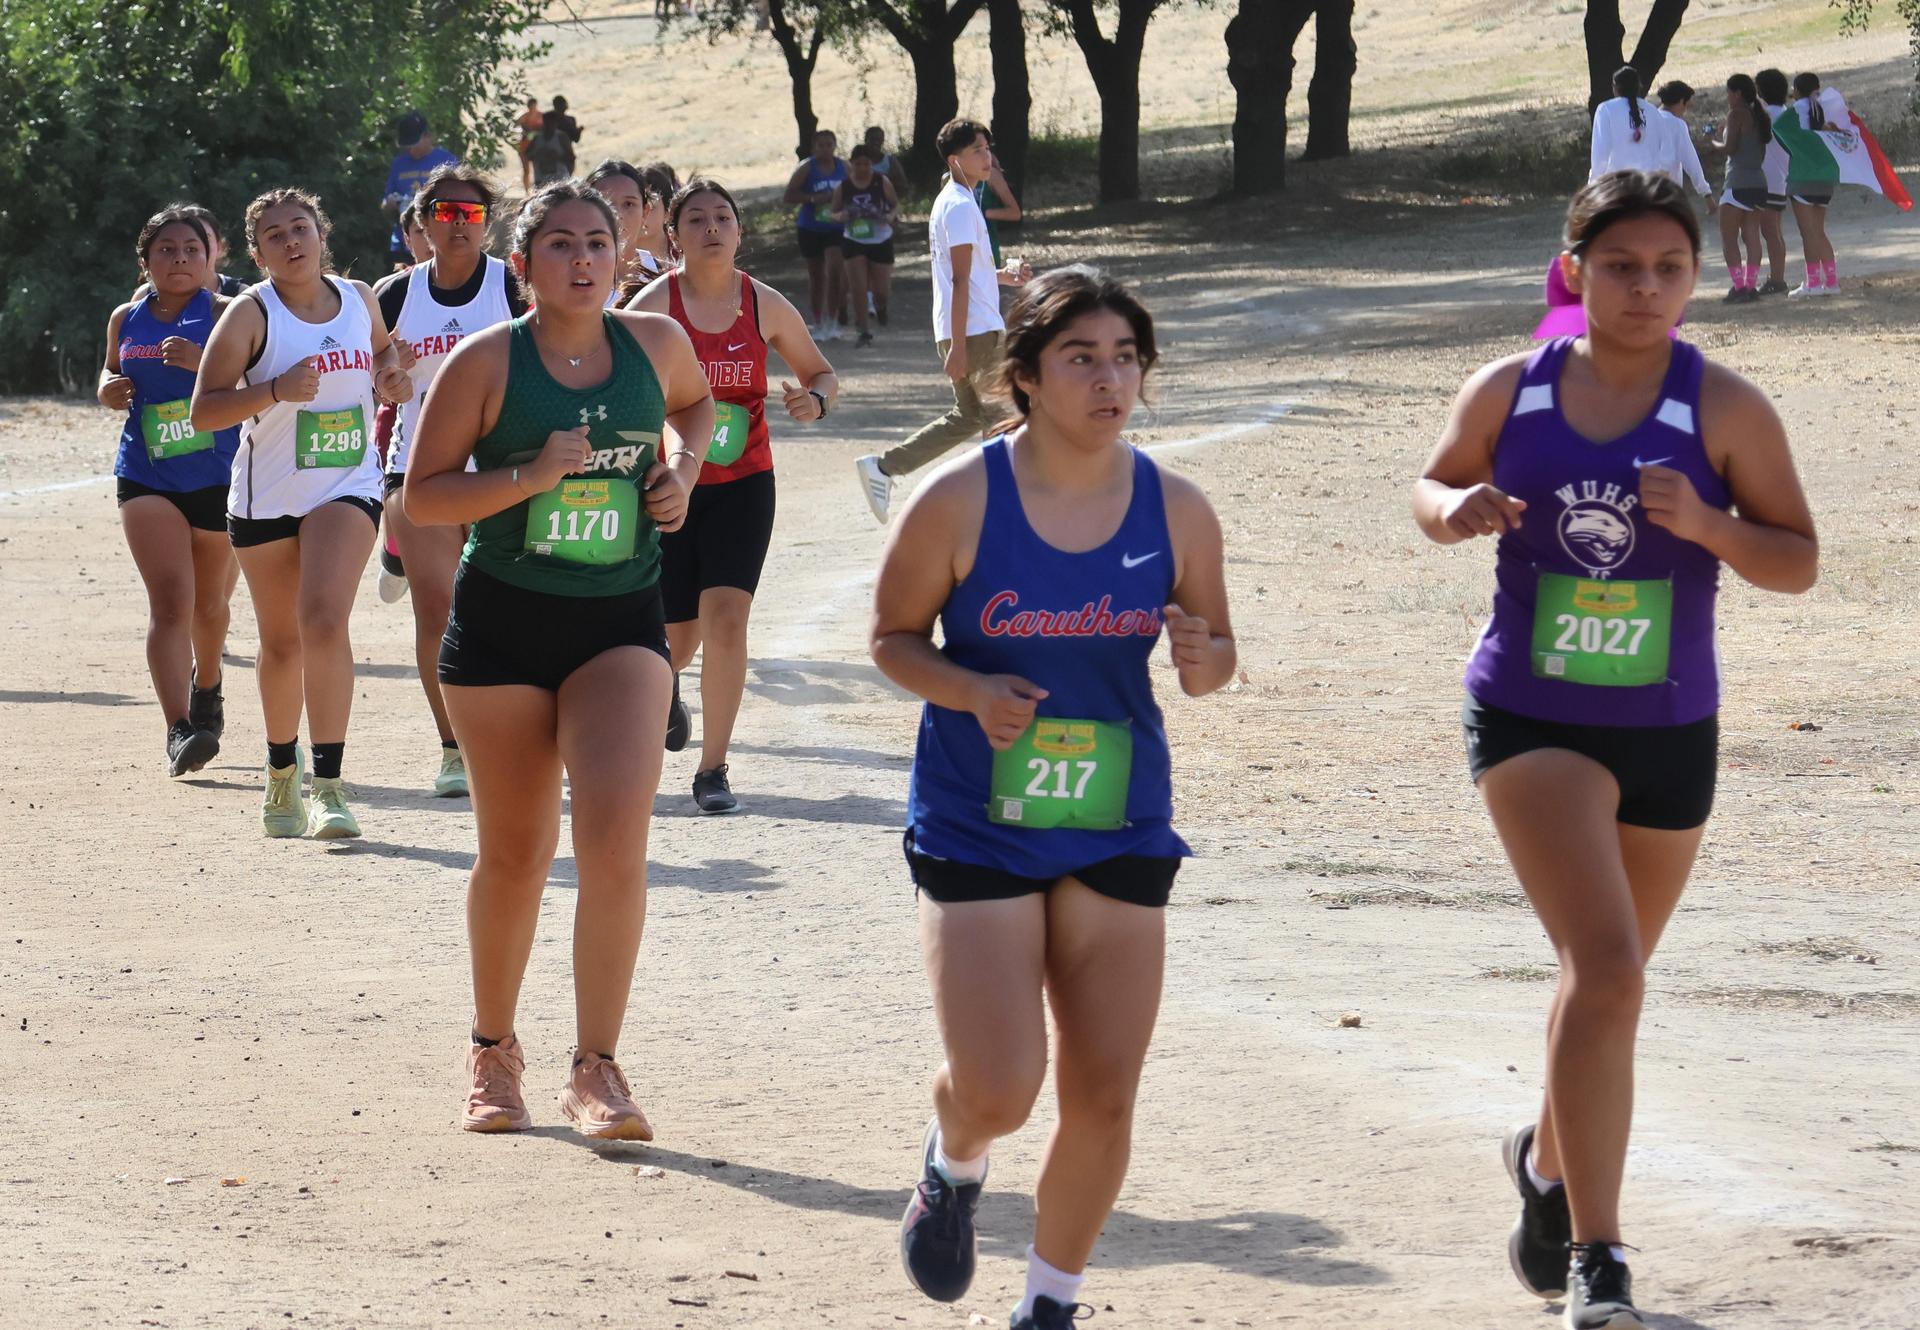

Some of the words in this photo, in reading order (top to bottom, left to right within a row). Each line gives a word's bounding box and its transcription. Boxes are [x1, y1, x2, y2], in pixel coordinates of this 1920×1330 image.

[410, 334, 465, 360] CFAR
[156, 418, 195, 443] 205
[310, 428, 362, 452] 1298
[583, 444, 646, 476] ERTY
[1554, 480, 1638, 513] WUHS
[546, 509, 620, 541] 1170
[1554, 613, 1651, 656] 2027
[1025, 757, 1098, 800] 217
